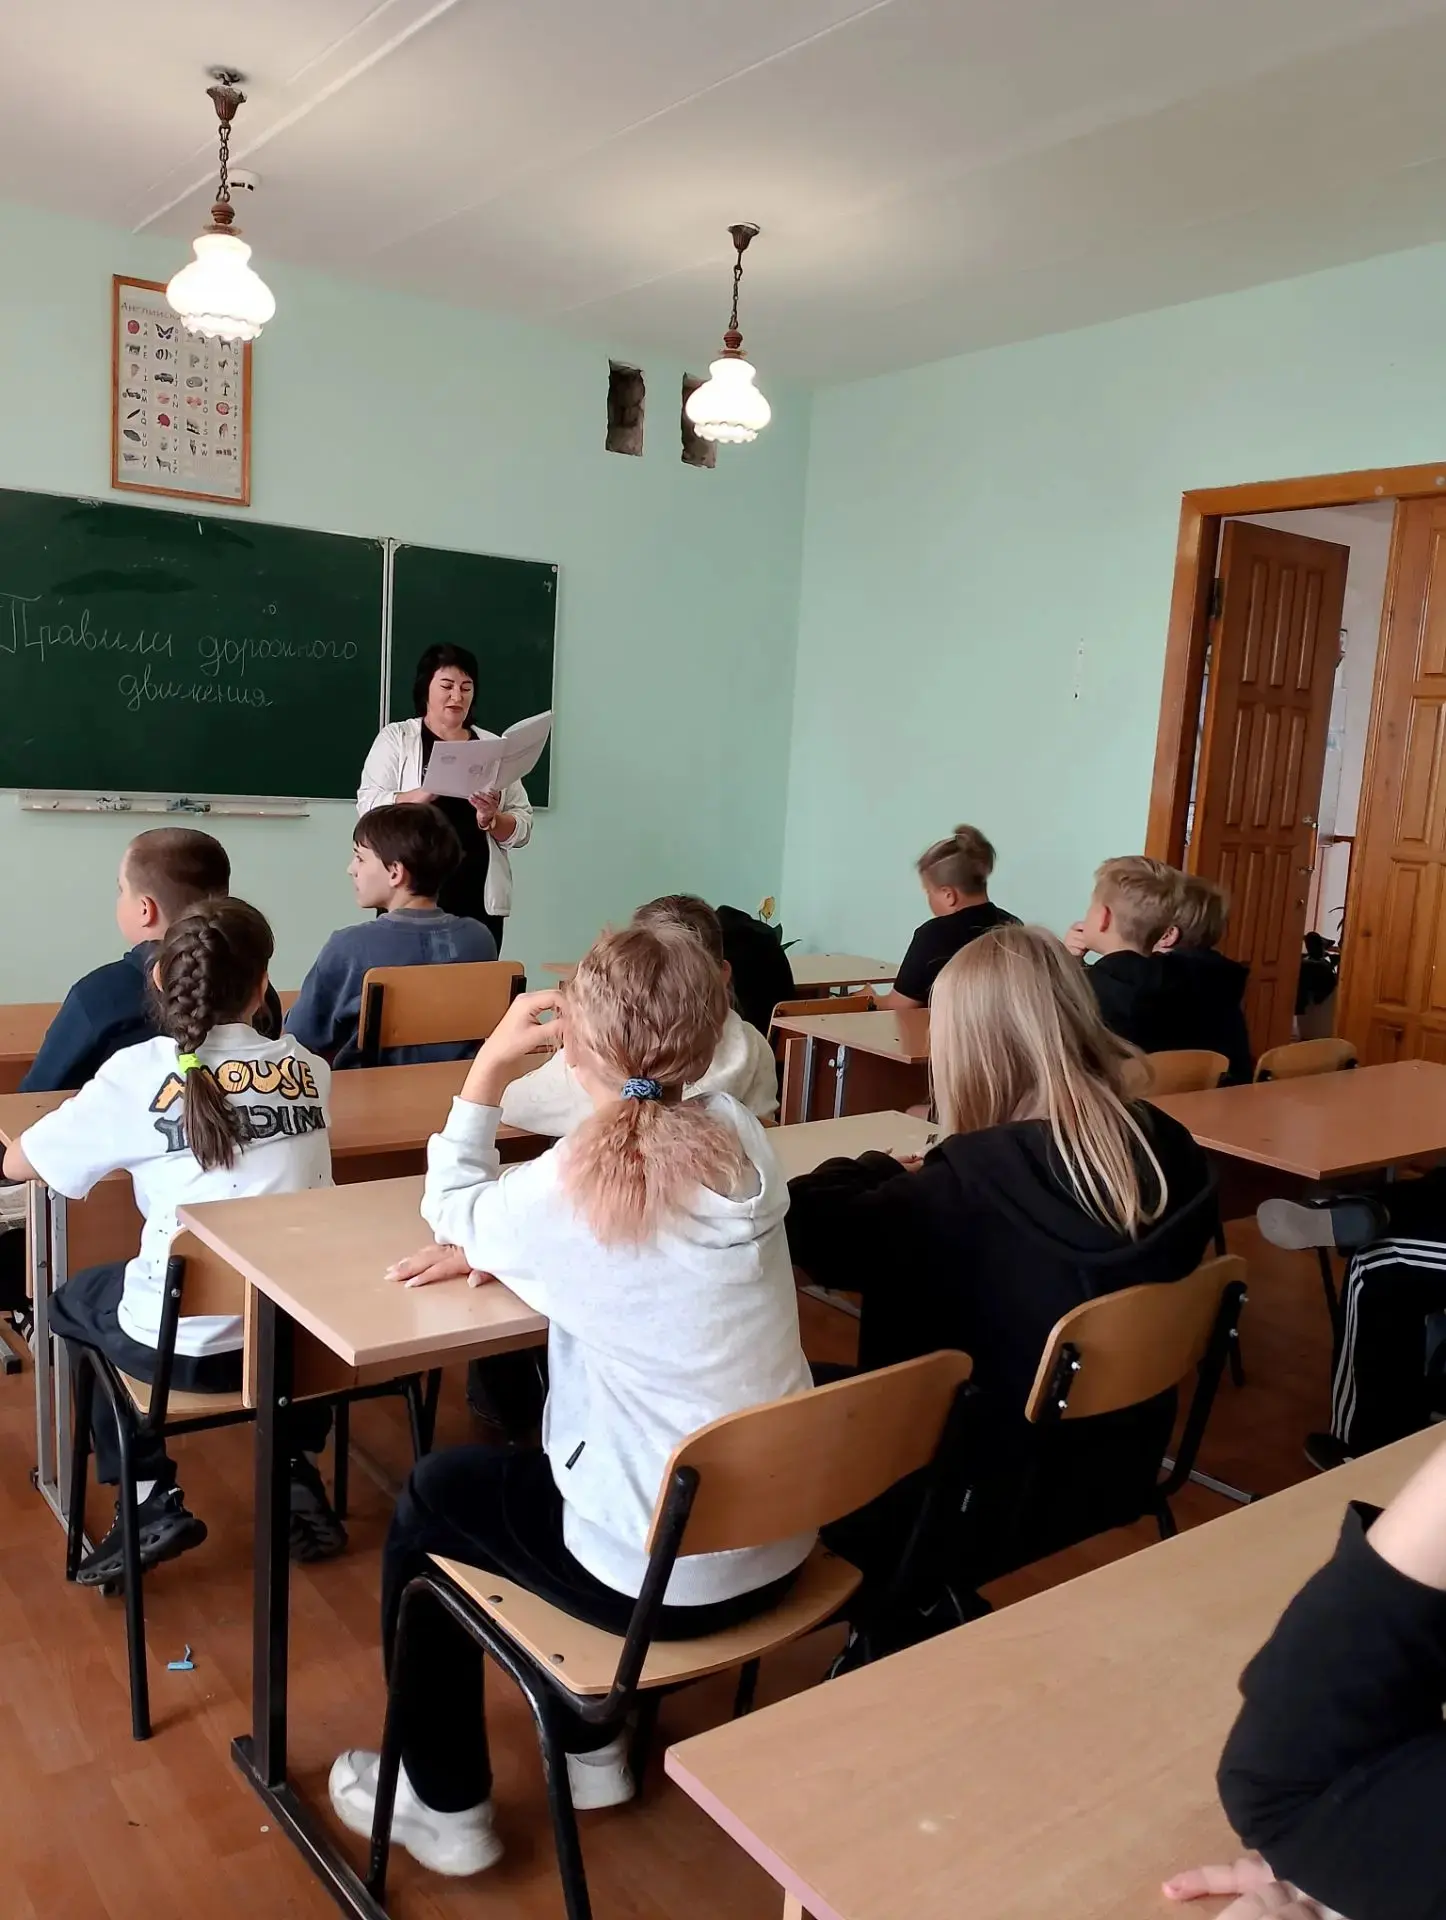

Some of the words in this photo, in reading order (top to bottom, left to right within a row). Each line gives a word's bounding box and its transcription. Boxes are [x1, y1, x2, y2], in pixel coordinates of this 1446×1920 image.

[0, 592, 173, 663] Правила
[197, 634, 358, 677] дорожного
[118, 664, 274, 712] движения
